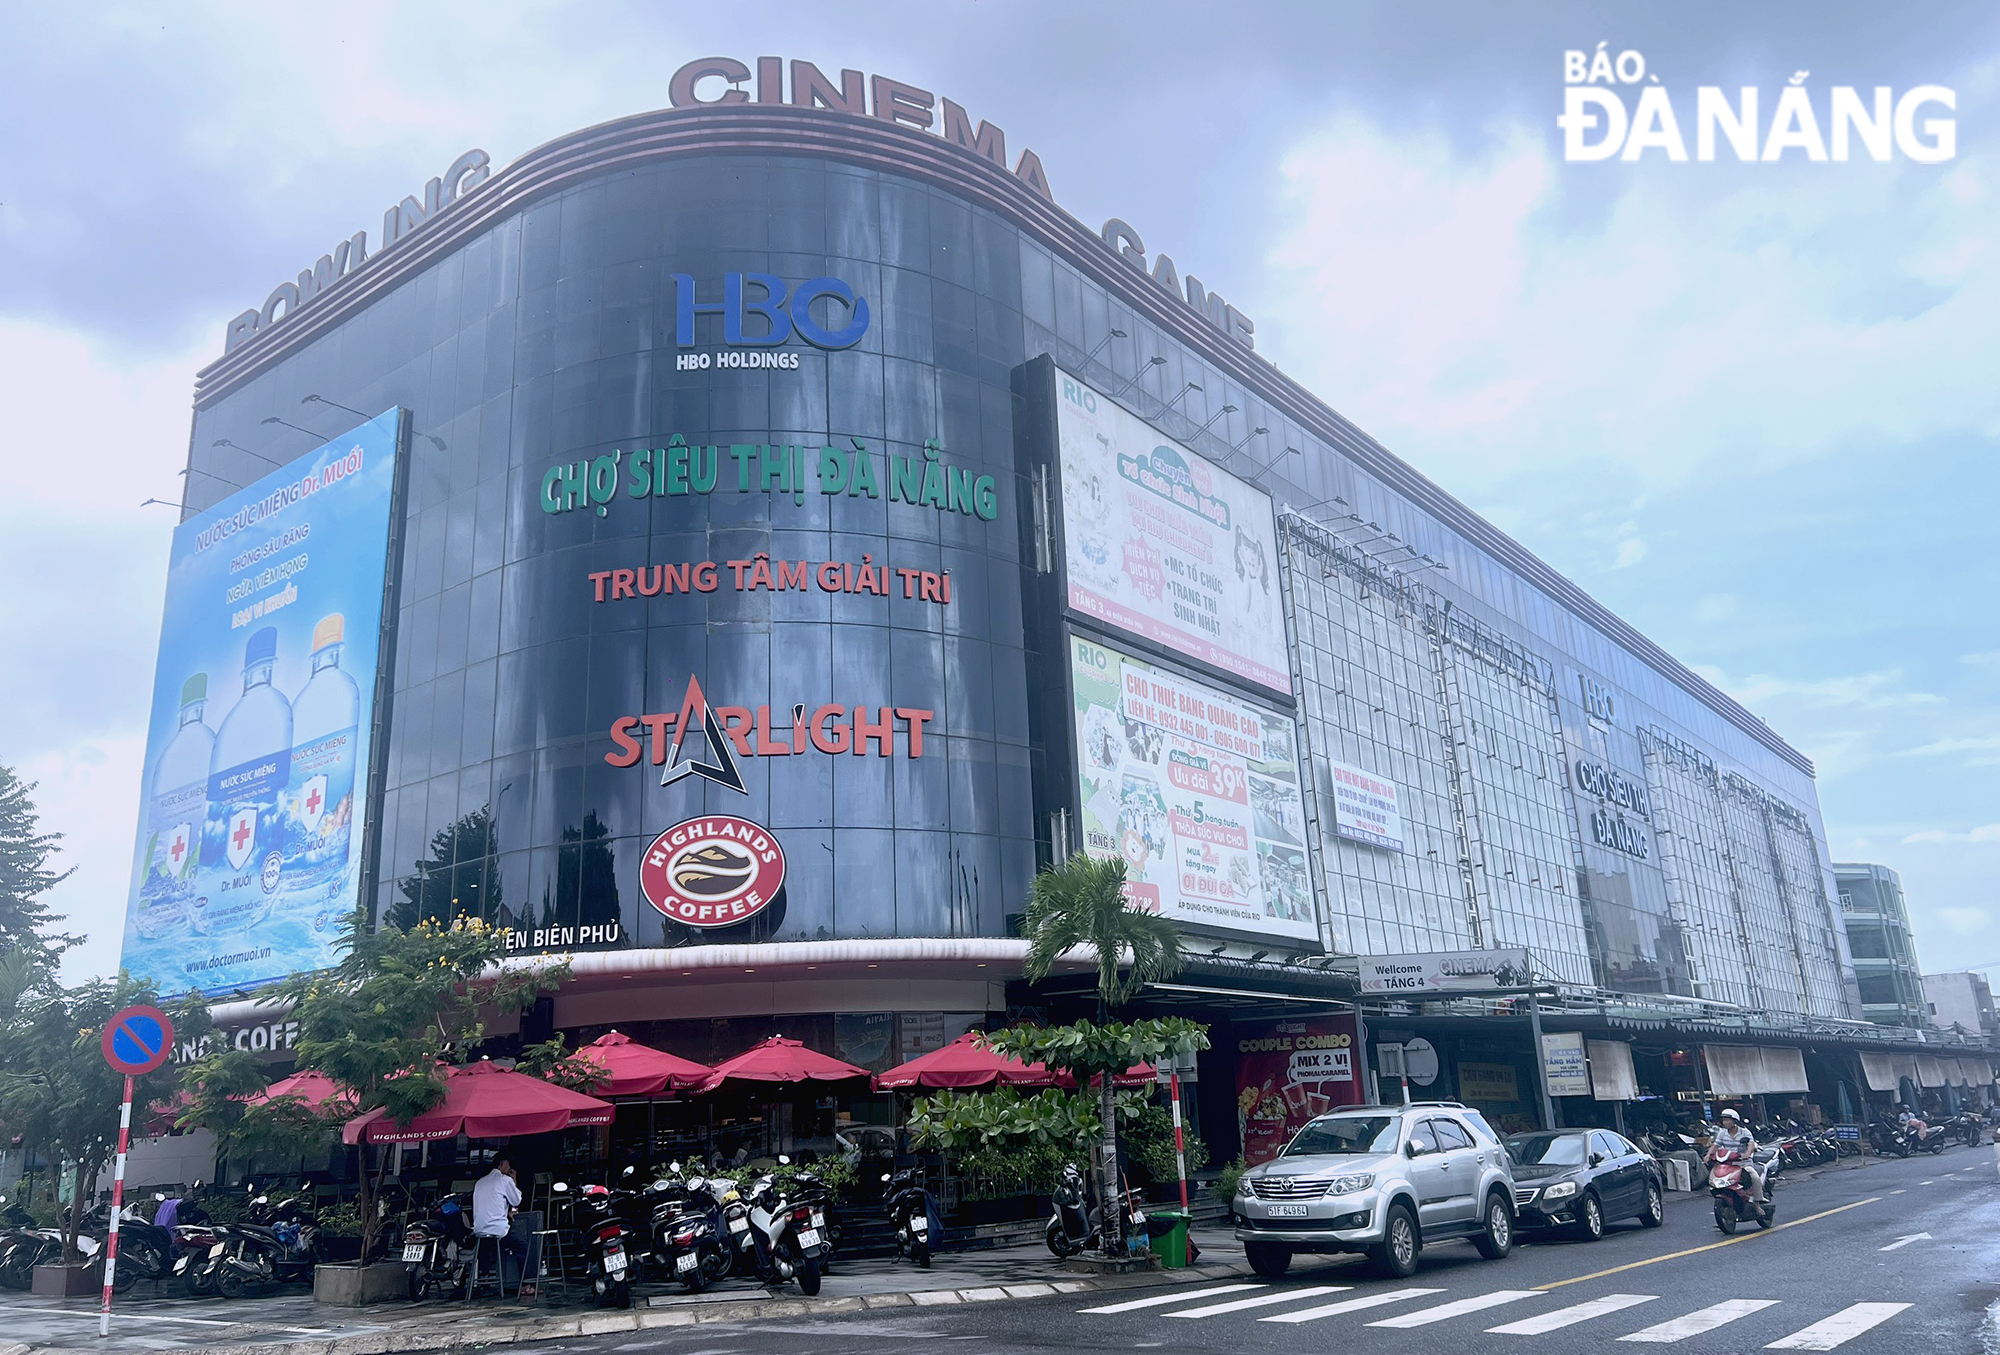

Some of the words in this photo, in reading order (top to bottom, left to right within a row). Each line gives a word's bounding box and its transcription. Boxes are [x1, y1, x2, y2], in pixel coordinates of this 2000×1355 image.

[669, 55, 1055, 203] CINEMA
[225, 148, 490, 356] BOWLING
[1100, 218, 1256, 351] GAME
[670, 271, 870, 350] HBO
[676, 352, 711, 371] HBO
[716, 352, 799, 371] HOLDINGS
[1063, 377, 1097, 414] RIO
[540, 449, 621, 519] CHỢ
[628, 433, 718, 497] SIÊU
[730, 444, 804, 507] THỊ
[817, 437, 879, 499] ĐÀ
[889, 438, 997, 521] NẴNG
[1152, 457, 1192, 487] Chuyên
[194, 519, 230, 554] NƯỚC
[230, 503, 256, 535] SÚC
[256, 484, 299, 521] MIỆNG
[301, 476, 321, 500] Dr.
[322, 445, 364, 488] MUỐI
[230, 546, 262, 575] PHÒNG
[262, 535, 282, 558] SÂU
[282, 524, 310, 550] RĂNG
[226, 576, 253, 604] NGỪA
[255, 565, 278, 590] VIÊM
[279, 553, 308, 582] HỌNG
[588, 559, 718, 603] TRUNG
[727, 552, 807, 591] TÂM
[817, 553, 890, 597] GIẢI
[897, 566, 952, 604] TRÍ
[1200, 570, 1224, 595] CHỨC
[1075, 591, 1097, 610] TẦNG
[1171, 582, 1201, 609] TRANG
[1203, 594, 1217, 615] TRÍ
[1173, 602, 1196, 626] SINH
[1198, 612, 1222, 637] NHẬT
[1078, 643, 1106, 670] RIO
[1126, 673, 1148, 699] CHO
[1151, 683, 1176, 710] THUÊ
[1179, 691, 1204, 719] BẢNG
[1207, 703, 1238, 731] QUẢNG
[1240, 714, 1259, 739] CÁO
[604, 673, 934, 796] STARLIGHT
[1127, 697, 1144, 719] LIÊN
[1159, 711, 1178, 731] 0932
[1180, 717, 1194, 736] 445
[1195, 723, 1208, 741] 001
[1214, 729, 1232, 749] 0905
[1576, 760, 1607, 804] CHỢ
[1607, 771, 1632, 809] SIÊU
[1631, 784, 1650, 823] THỊ
[1175, 804, 1191, 817] Thứ
[1193, 800, 1204, 824] 5
[1205, 813, 1222, 827] hàng
[1223, 818, 1239, 829] tuần
[1592, 809, 1616, 848] ĐÀ
[649, 822, 779, 870] HIGHLANDS
[1087, 827, 1109, 849] TẦNG
[1111, 836, 1116, 850] 3
[1186, 847, 1201, 857] MUA
[1201, 842, 1211, 864] 2
[1212, 829, 1225, 842] VUI
[1226, 833, 1245, 848] CHƠI
[221, 881, 231, 892] Dr.
[232, 871, 252, 890] MUỐI
[1185, 859, 1201, 871] tặng
[1202, 864, 1216, 874] ngay
[663, 889, 763, 920] COFFEE
[533, 922, 574, 947] BIÊN
[580, 918, 619, 944] PHỦ
[186, 946, 271, 974] www.doctormuoi.vn
[1375, 965, 1422, 975] Wellcome
[1439, 957, 1496, 976] CINEMA
[1384, 976, 1415, 988] TẦNG
[1418, 977, 1424, 987] 4
[1239, 1037, 1292, 1052] COUPLE
[1295, 1033, 1352, 1049] COMBO
[1297, 1055, 1319, 1067] MIX
[1324, 1055, 1331, 1066] 2
[1335, 1054, 1348, 1067] VỊ
[373, 1131, 424, 1140] HIGHLANDS
